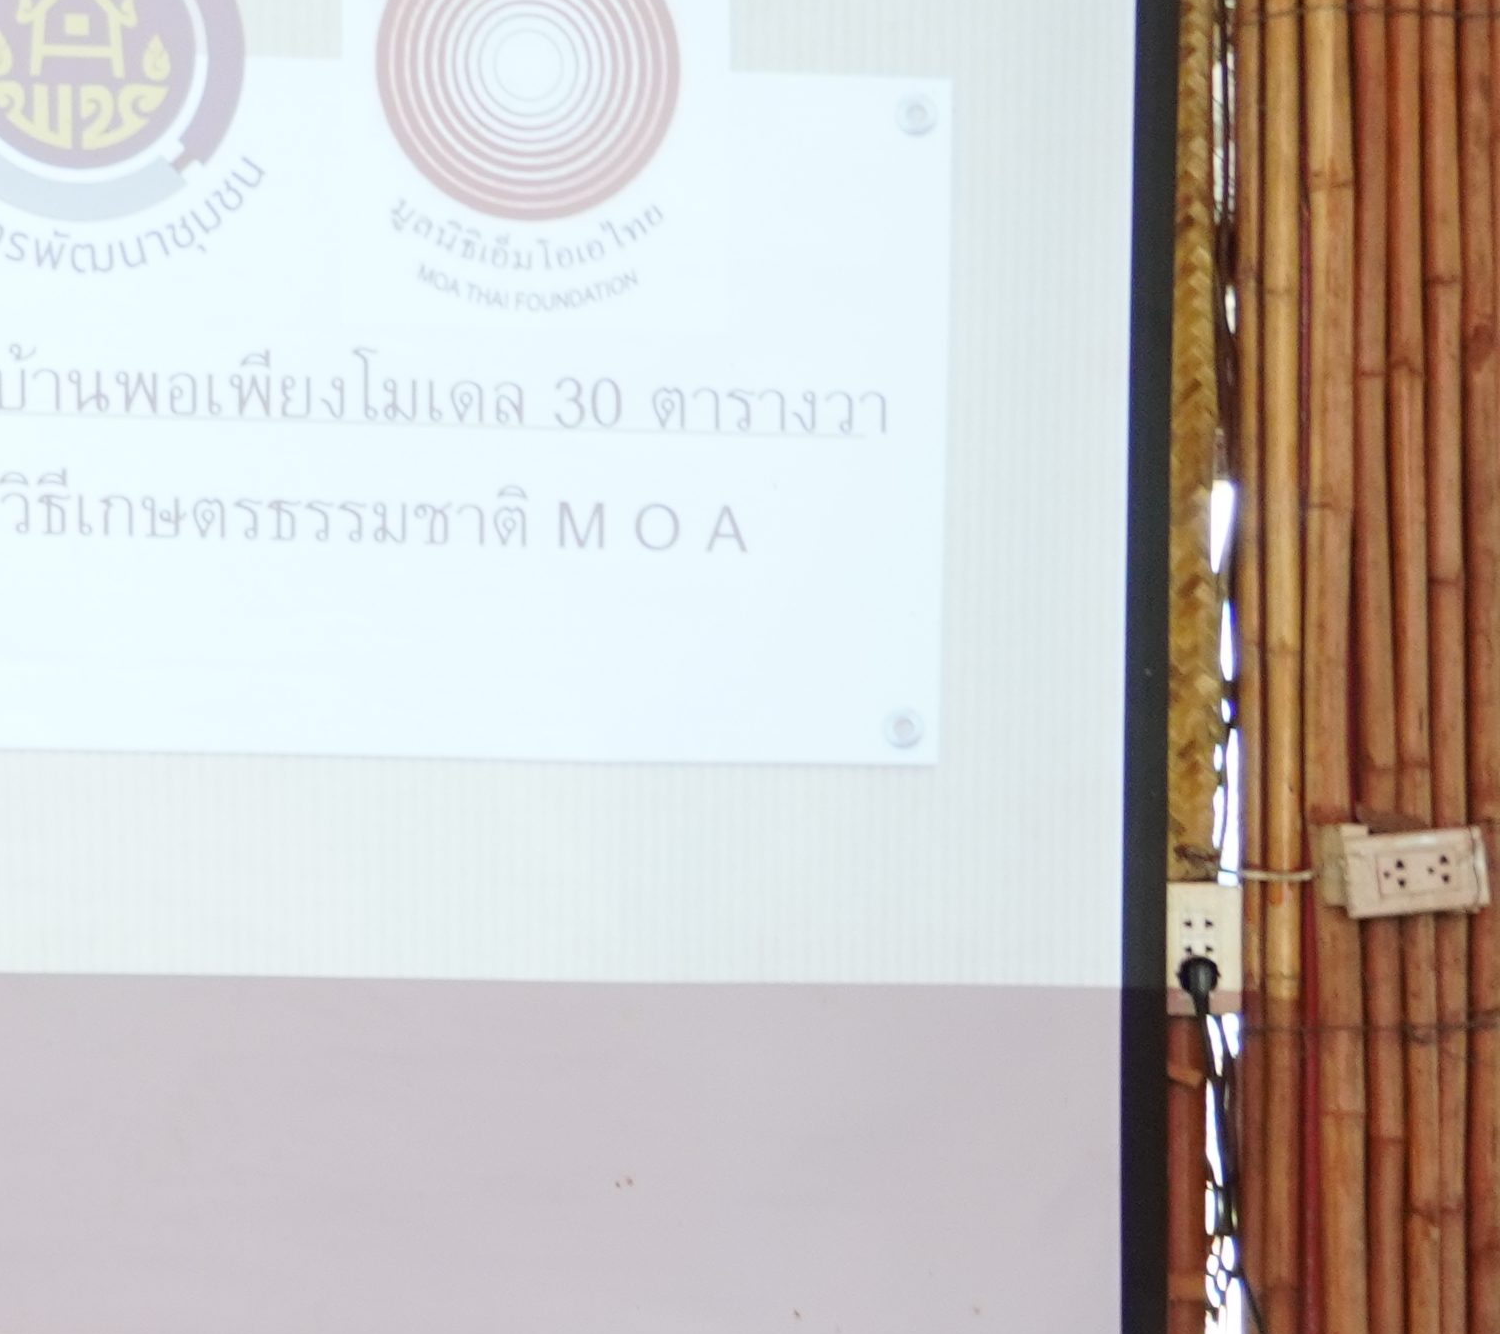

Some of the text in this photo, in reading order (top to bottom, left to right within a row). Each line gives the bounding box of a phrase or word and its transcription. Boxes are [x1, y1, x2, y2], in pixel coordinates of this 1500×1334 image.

[416, 263, 640, 315] MOA THAI FOUNDATION
[554, 376, 623, 429] 30
[652, 385, 888, 435] ตารางวา
